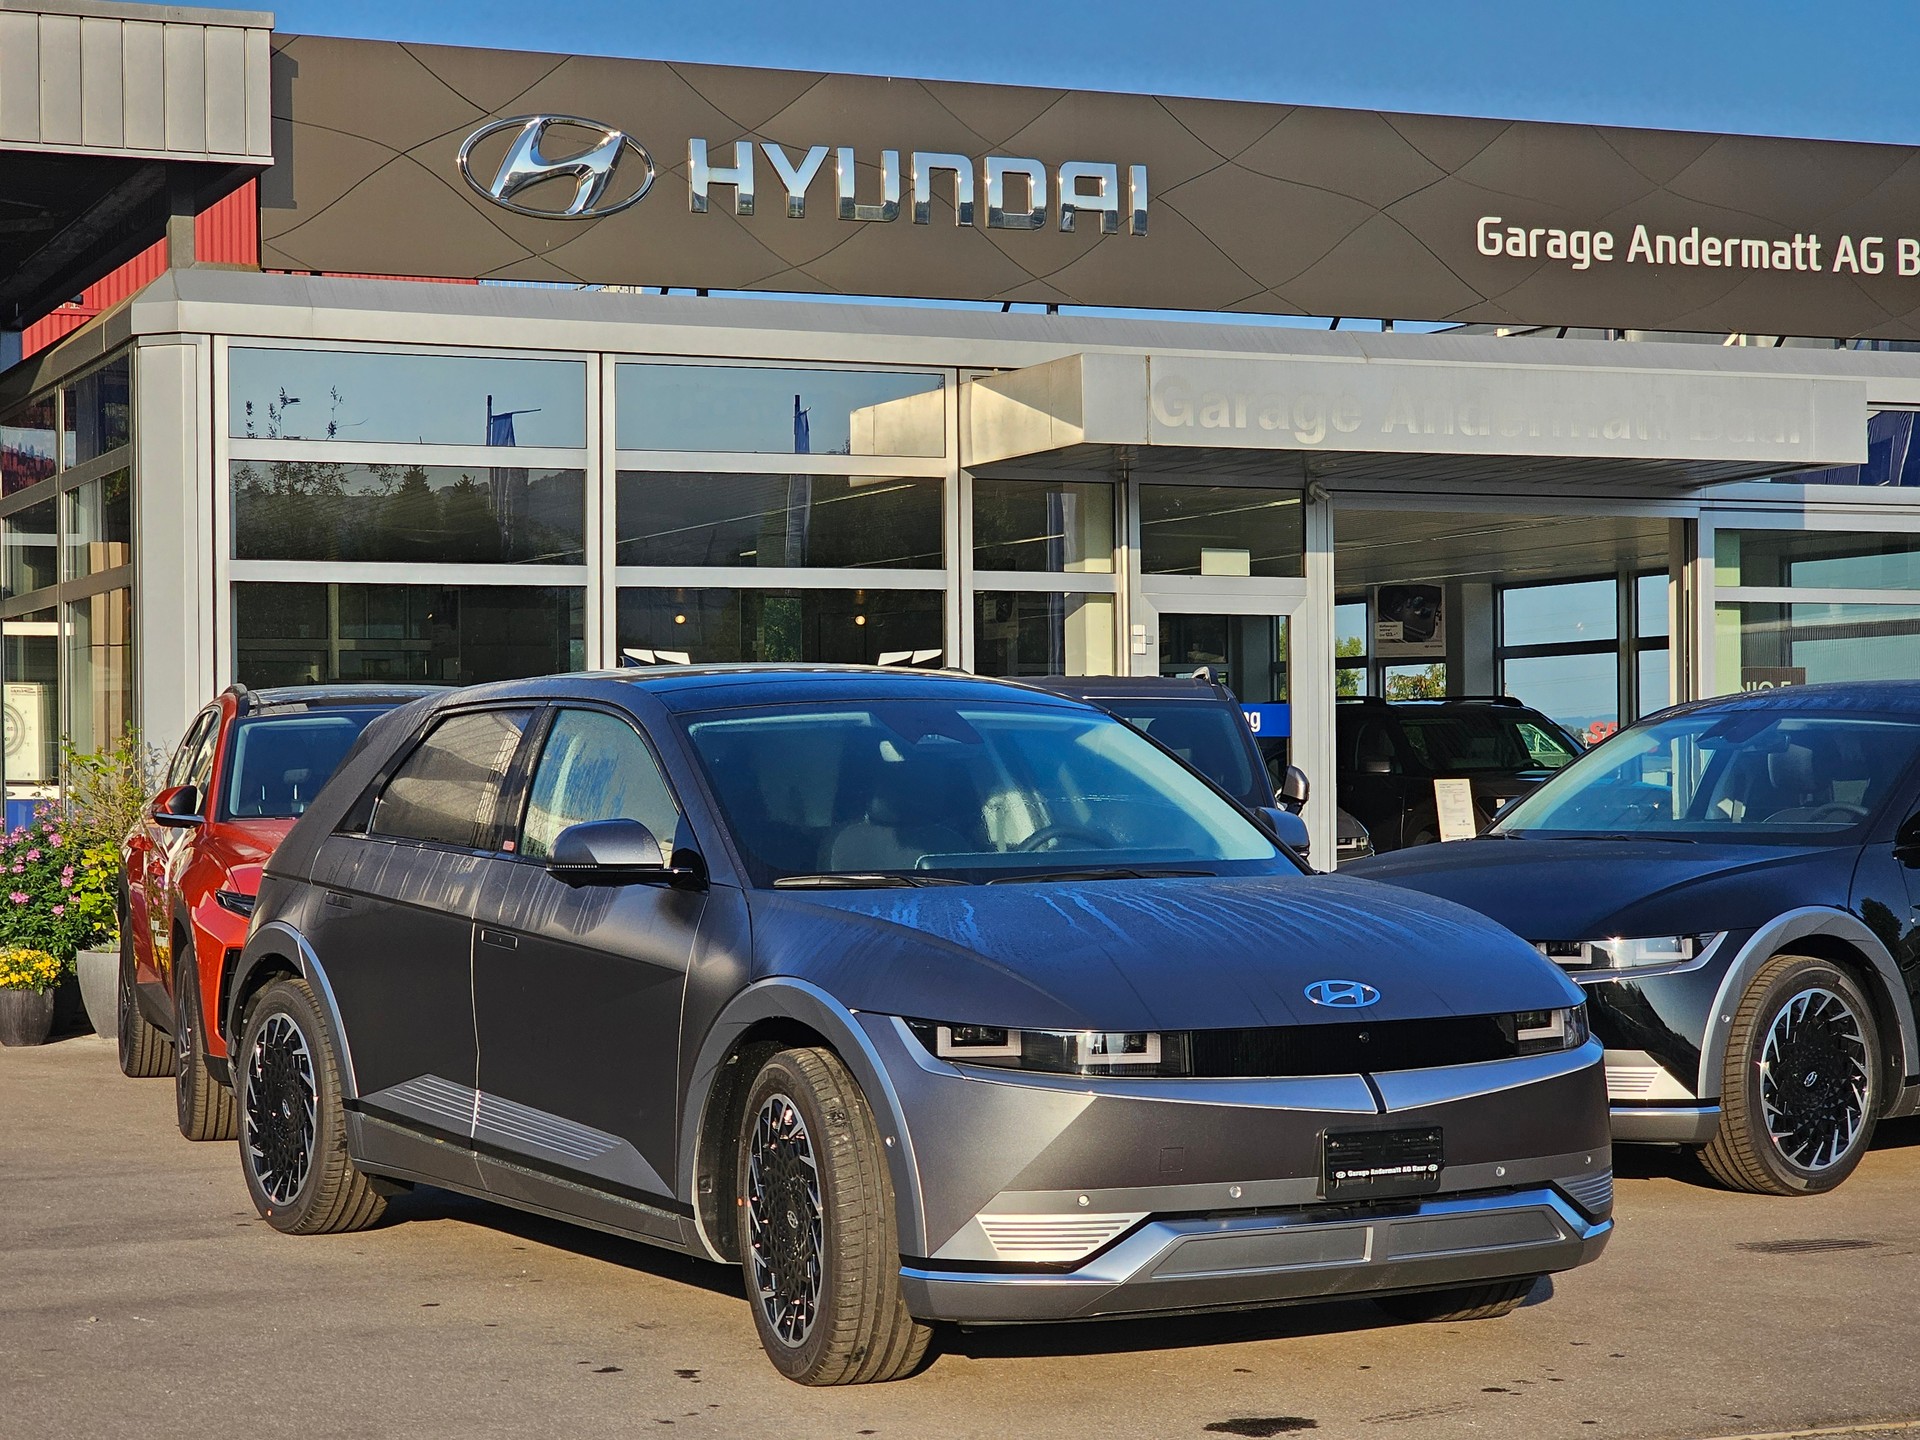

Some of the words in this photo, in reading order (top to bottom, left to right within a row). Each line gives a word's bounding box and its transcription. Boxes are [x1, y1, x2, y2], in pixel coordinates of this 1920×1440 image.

[687, 137, 1148, 237] HYUNDAI
[1476, 216, 1614, 270] Garage
[1626, 224, 1822, 272] Andermatt
[1832, 235, 1885, 275] AG
[1151, 374, 1363, 445] Garage
